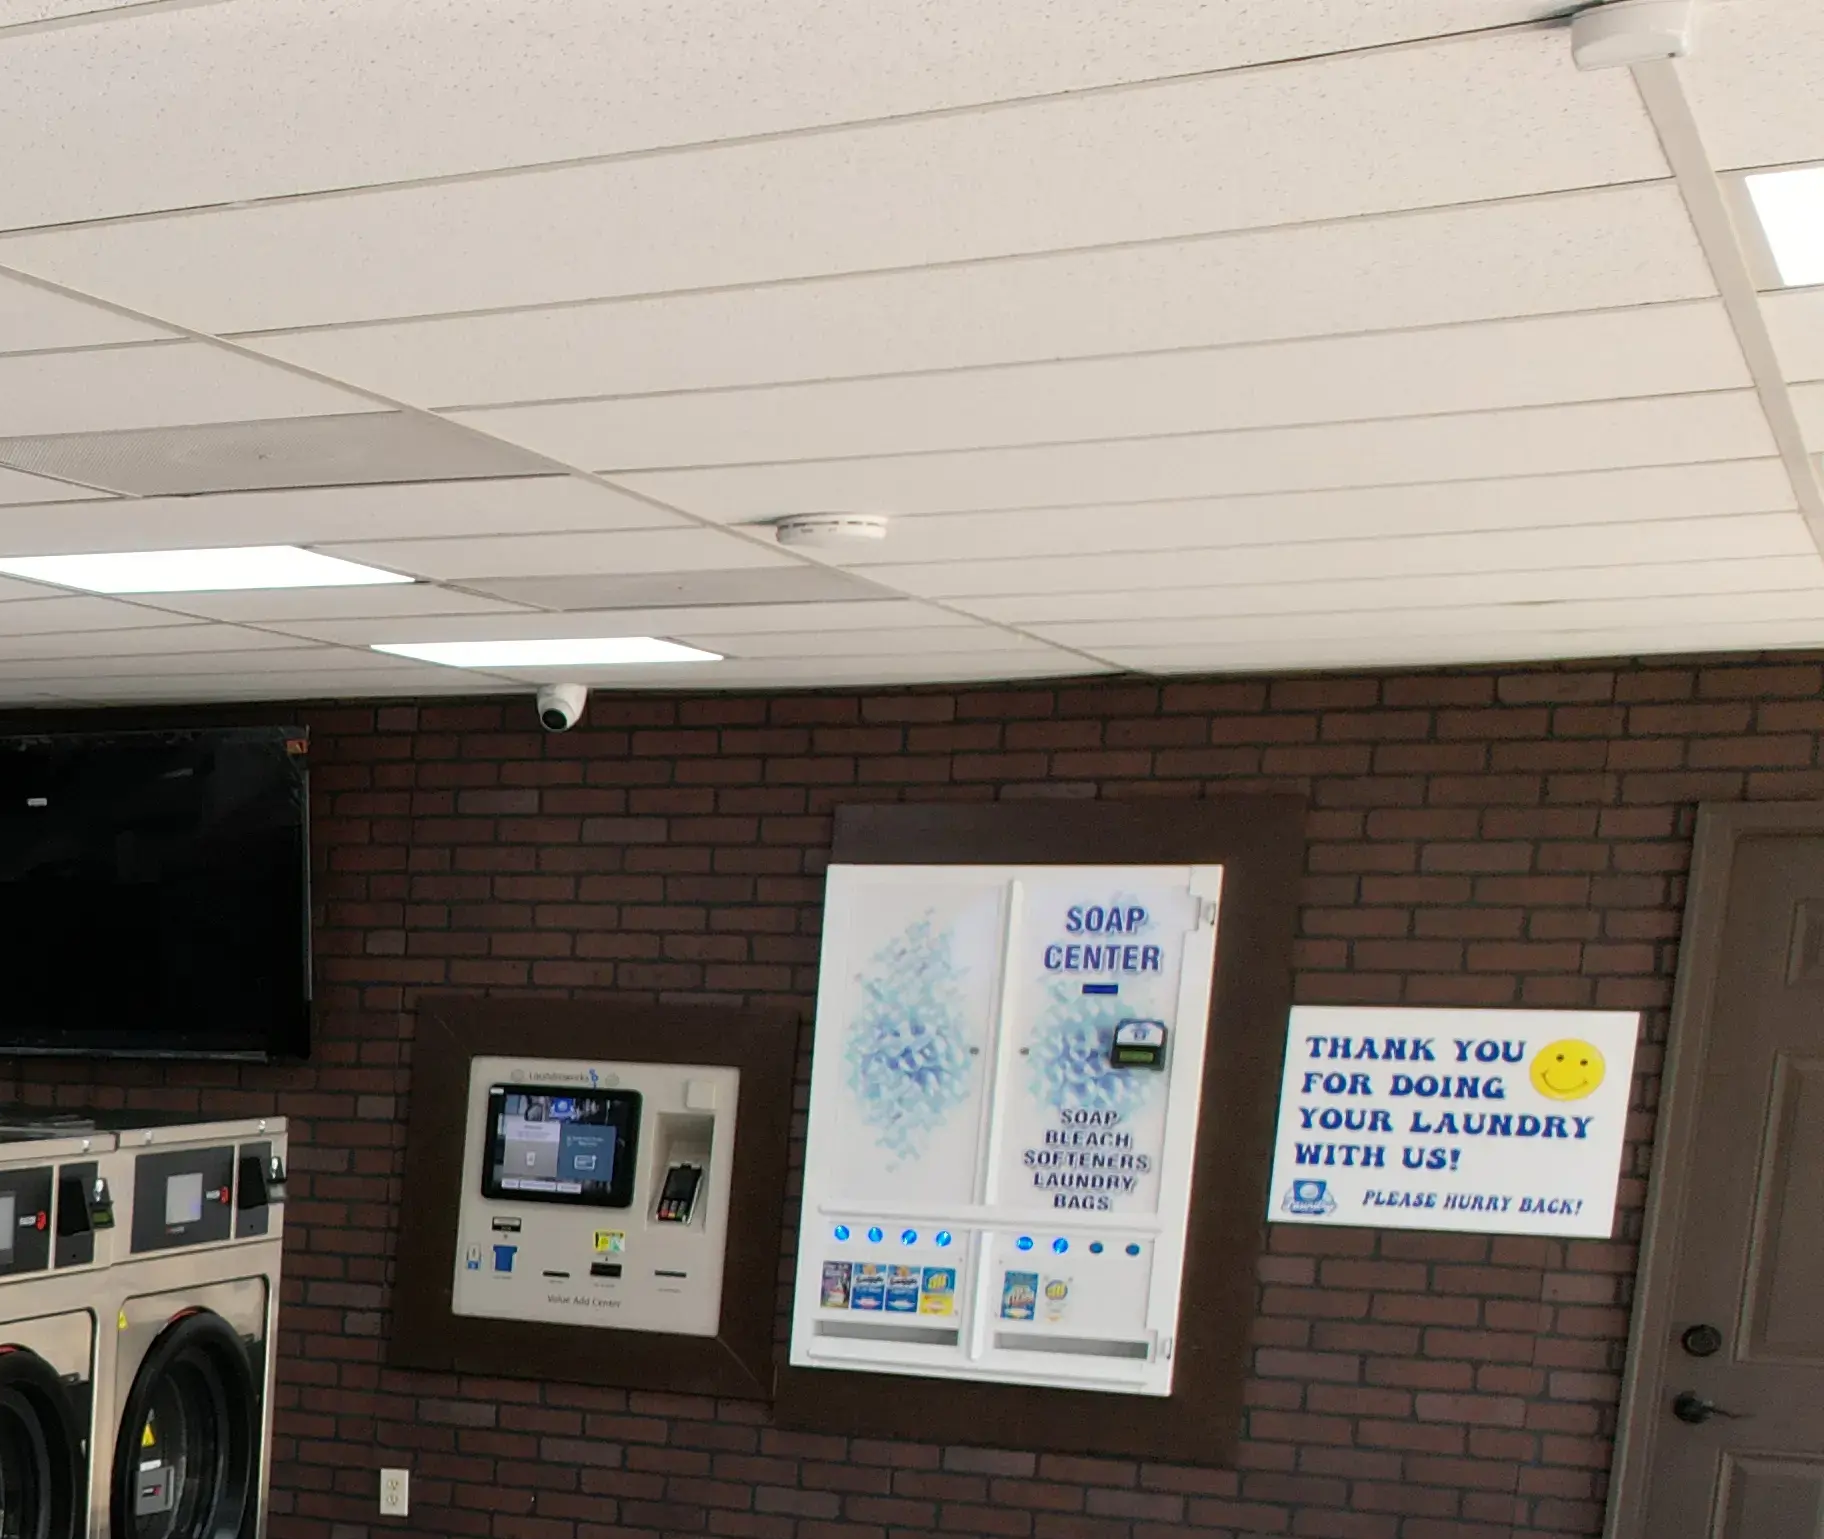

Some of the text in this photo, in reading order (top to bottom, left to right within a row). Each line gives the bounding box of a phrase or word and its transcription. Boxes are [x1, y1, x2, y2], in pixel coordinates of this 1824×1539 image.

[1065, 905, 1147, 933] SOAP
[1044, 944, 1161, 972] CENTER
[1306, 1036, 1526, 1063] THANK YOU
[1301, 1072, 1506, 1099] FOR DOING
[1060, 1108, 1119, 1126] SOAP
[1299, 1107, 1595, 1139] YOUR LAUNDRY
[1045, 1129, 1132, 1148] BLEACH
[1023, 1149, 1149, 1171] SOFTENERS
[1295, 1143, 1461, 1171] WITH US!
[1033, 1172, 1136, 1192] LAUNDRY
[1053, 1193, 1112, 1211] BAGS
[1362, 1190, 1583, 1216] PLEASE HURRY BACK!
